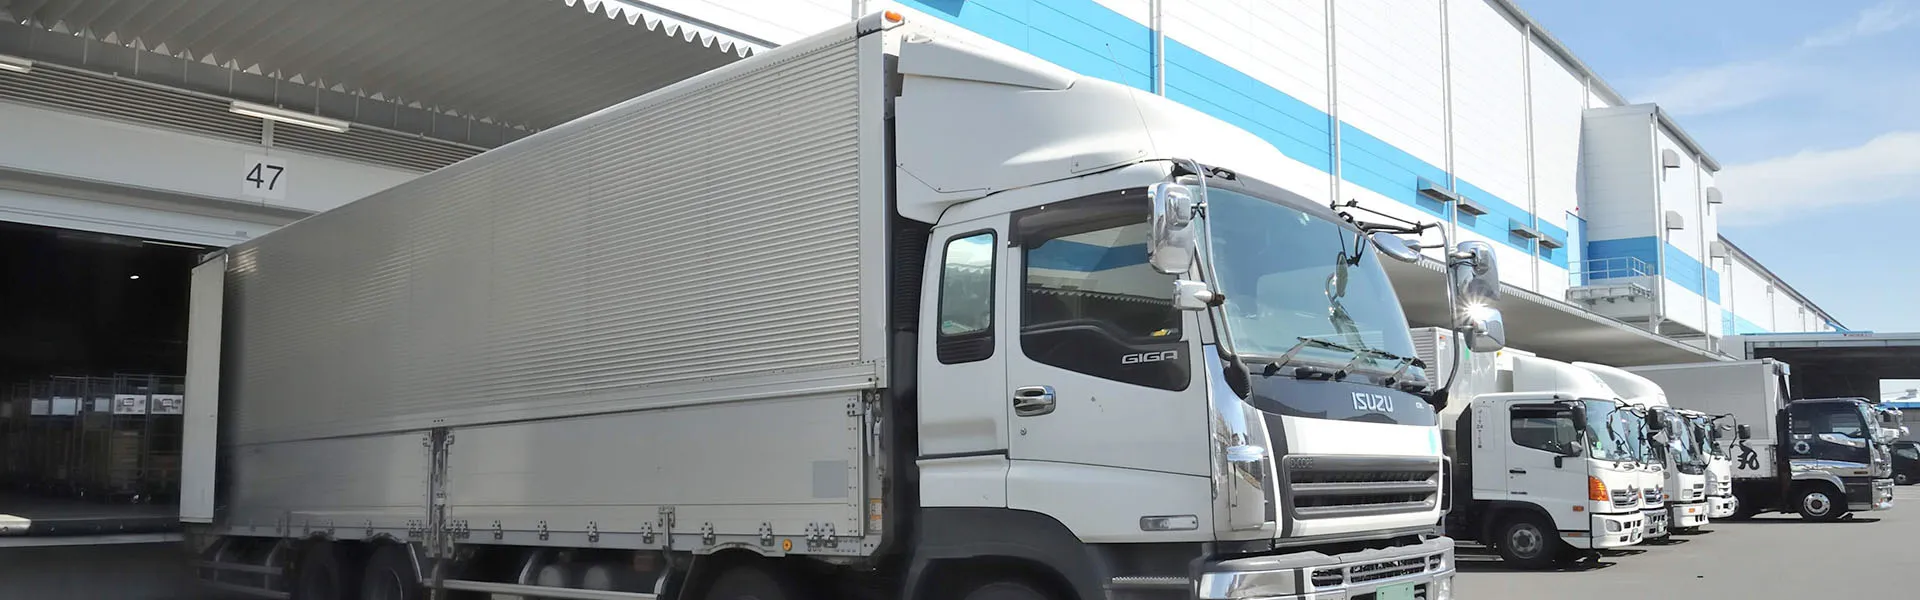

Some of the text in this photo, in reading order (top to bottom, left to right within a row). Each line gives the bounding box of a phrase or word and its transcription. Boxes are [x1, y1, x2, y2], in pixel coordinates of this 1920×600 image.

[246, 163, 284, 190] 47
[1121, 350, 1178, 364] GIGA
[1352, 392, 1394, 412] ISUZU
